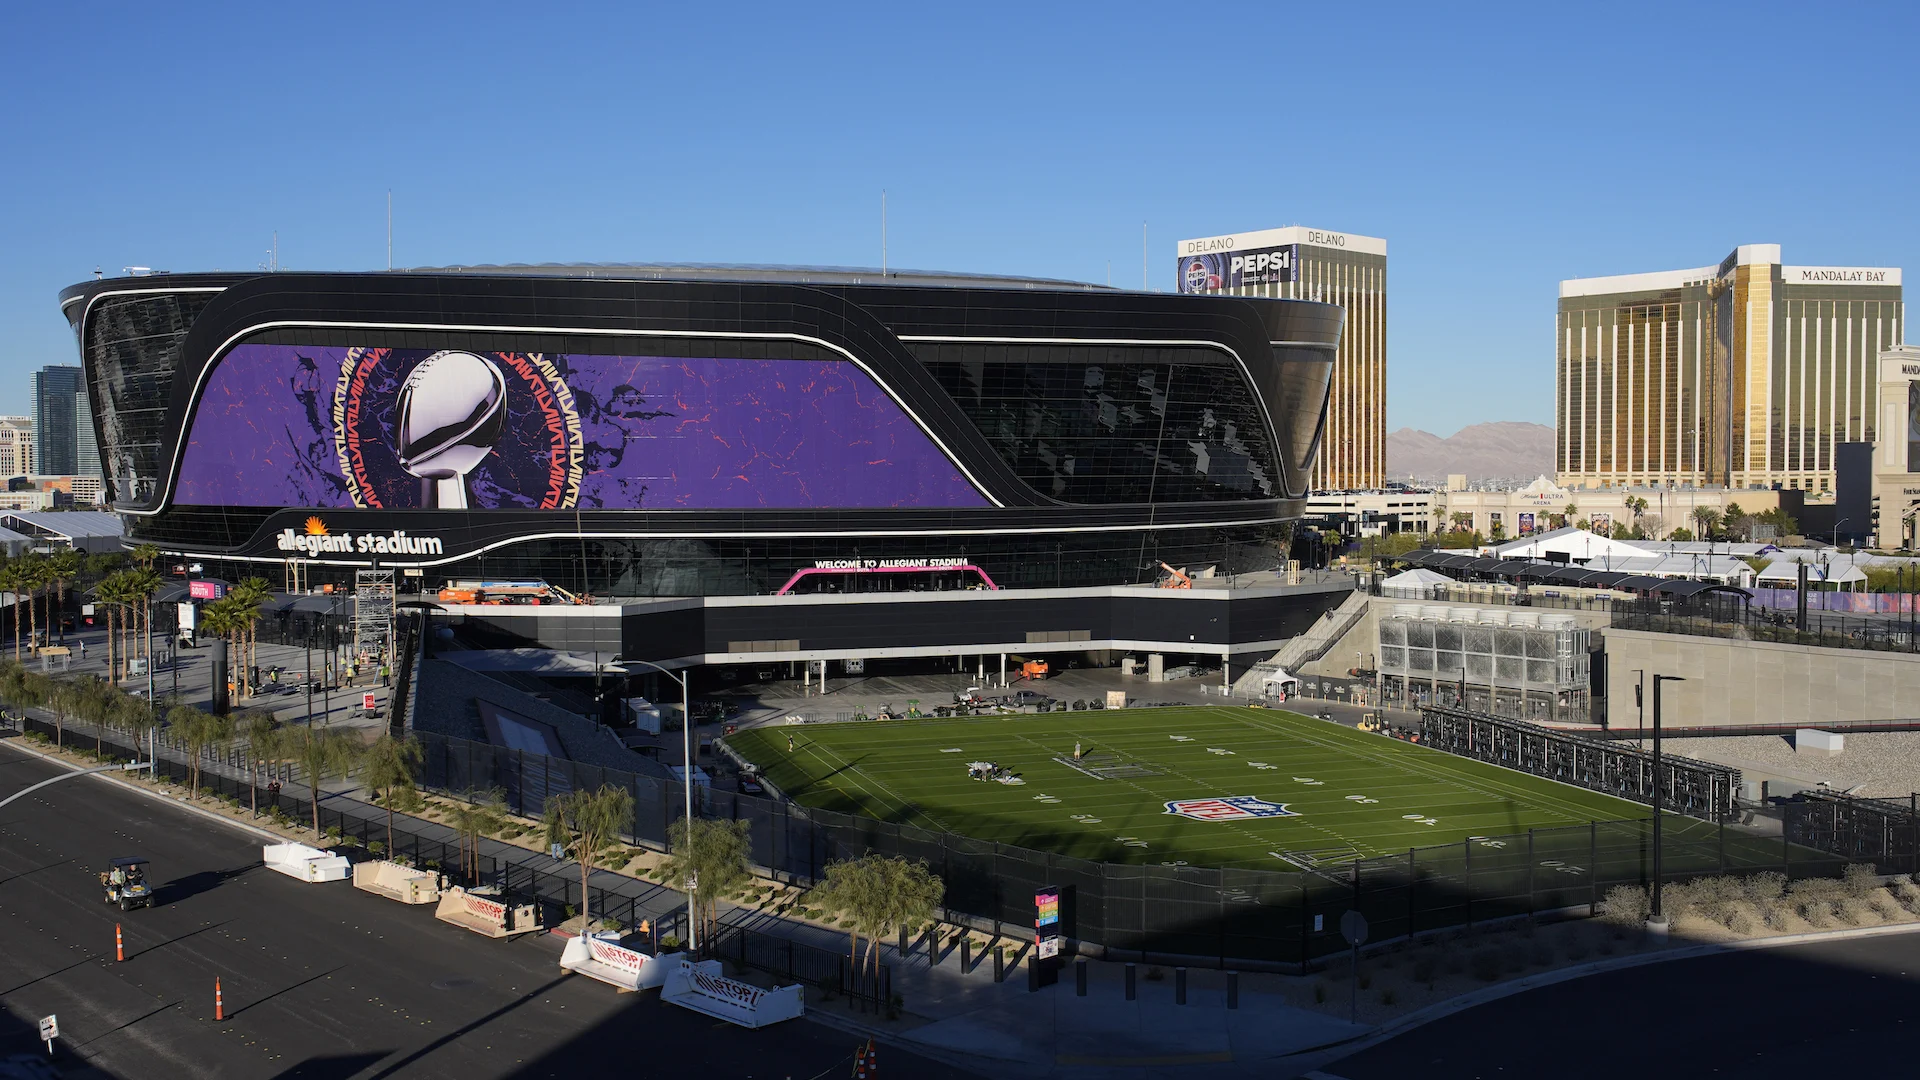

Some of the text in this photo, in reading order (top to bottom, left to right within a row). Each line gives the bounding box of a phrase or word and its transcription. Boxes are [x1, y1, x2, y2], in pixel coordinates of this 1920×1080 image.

[1188, 237, 1234, 253] DELANO
[1308, 231, 1345, 247] DELANO
[1231, 251, 1289, 275] PEPSI
[1802, 270, 1886, 281] MANDALAY BAY
[276, 528, 443, 557] allegiant stadium
[815, 557, 968, 569] WELCOME TO ALLEGIANT STADIUM
[191, 586, 209, 597] SOUTH
[477, 901, 502, 914] STOP
[607, 947, 639, 962] STOP
[714, 979, 752, 997] STOP
